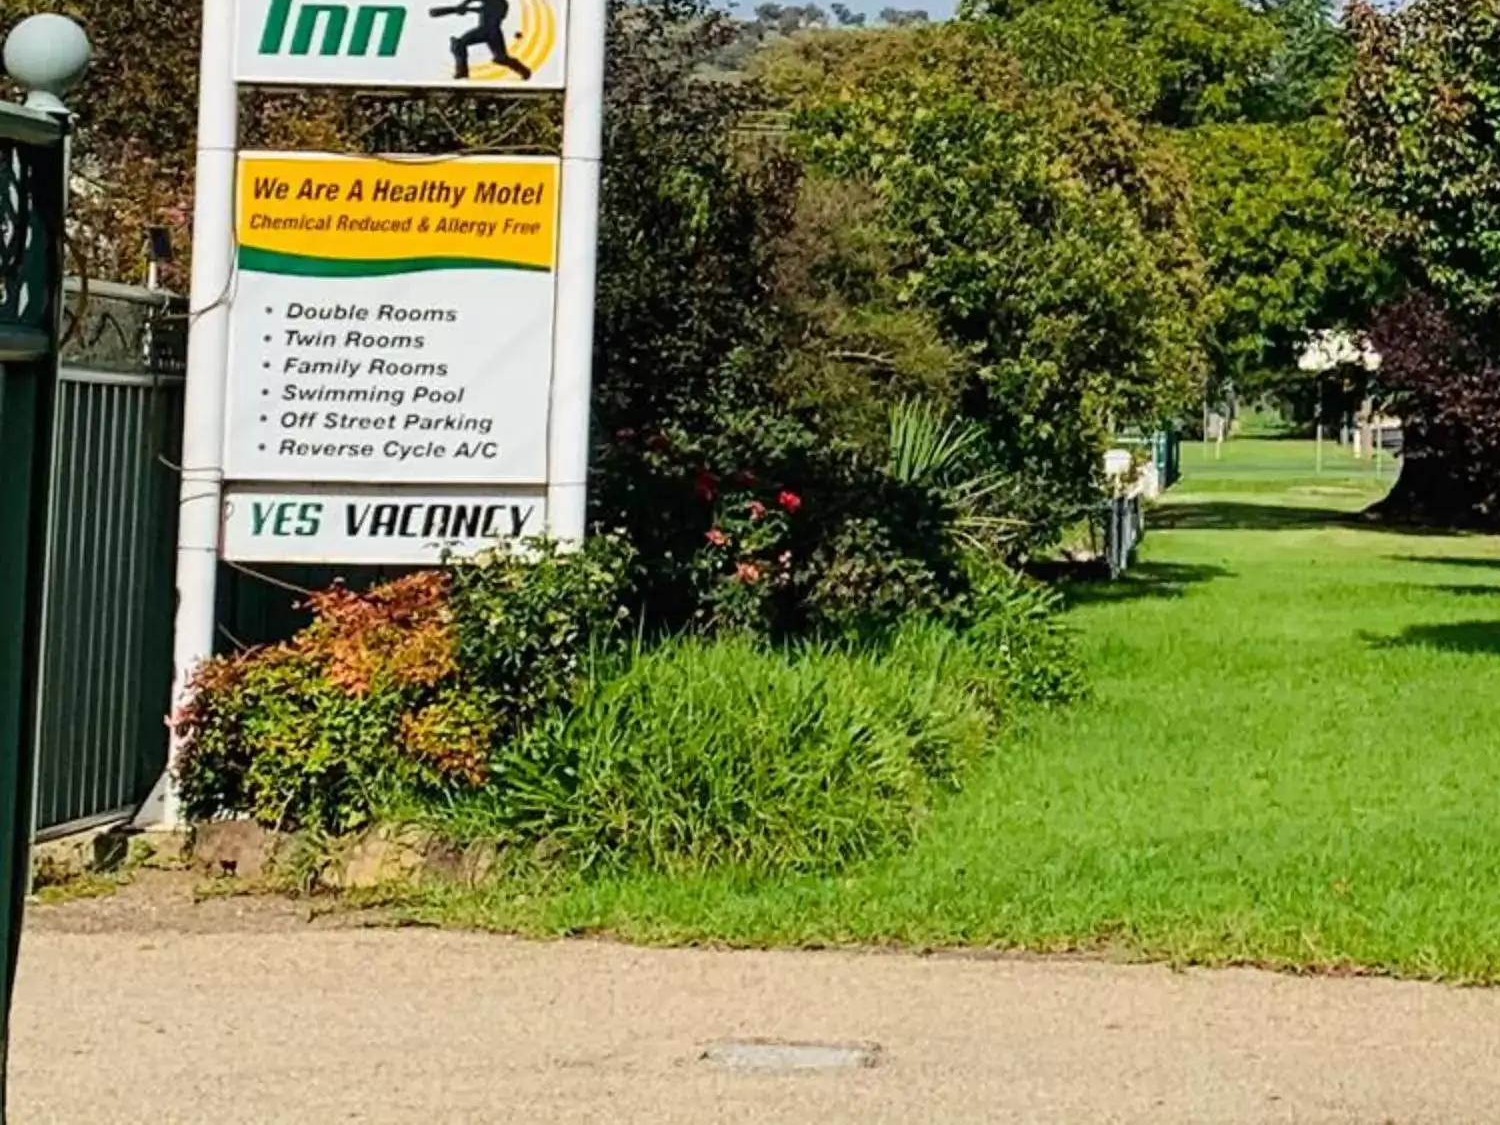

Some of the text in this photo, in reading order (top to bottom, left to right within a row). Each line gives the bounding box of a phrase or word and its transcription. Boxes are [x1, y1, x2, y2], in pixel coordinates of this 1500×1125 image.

[253, 177, 544, 208] We Are A Healthy Motel
[250, 214, 540, 236] Chemical Reduced & Allergy Free
[286, 303, 457, 322] Double Rooms
[284, 331, 425, 349] Twin Rooms
[283, 359, 449, 378] Family Rooms
[281, 385, 465, 405] Swimming Pool
[280, 412, 493, 433] Off Street Parking
[278, 441, 498, 460] Reverse Cycle A/C
[251, 502, 534, 538] YES VACANCY
